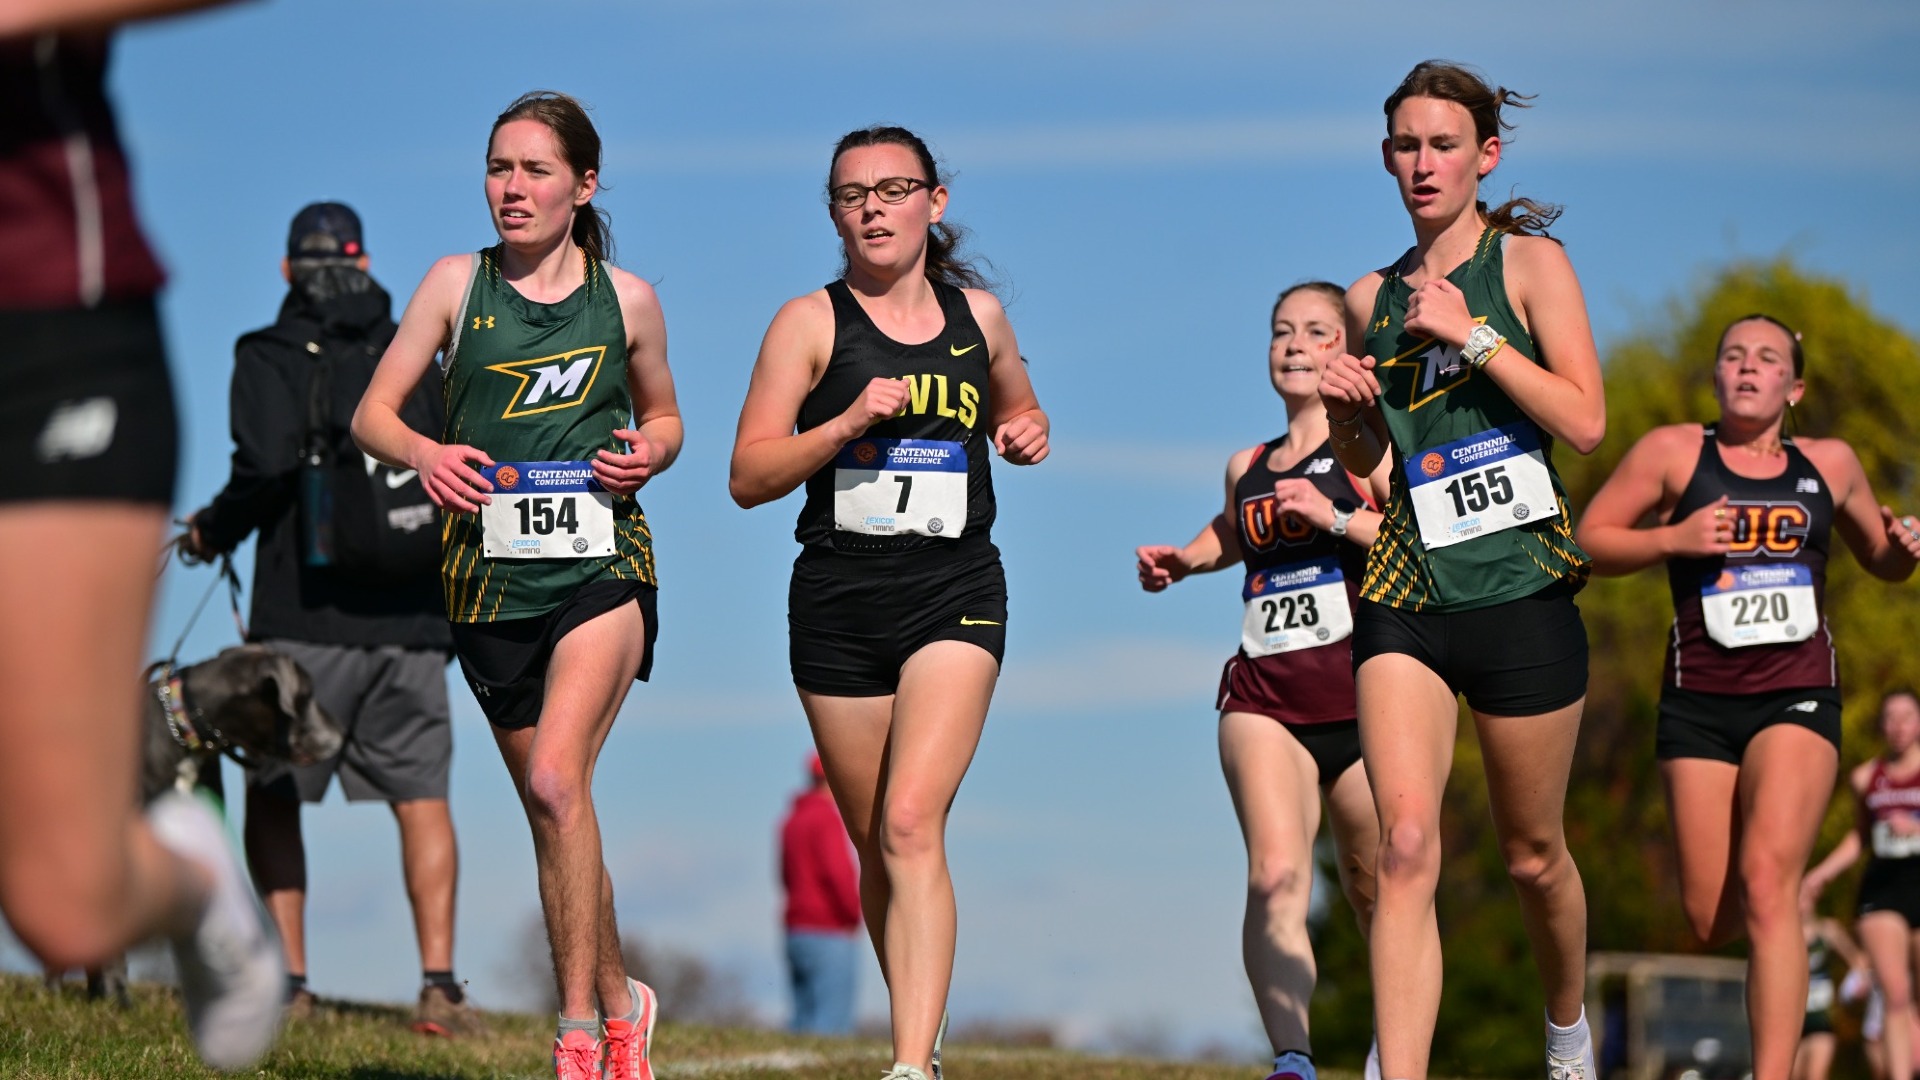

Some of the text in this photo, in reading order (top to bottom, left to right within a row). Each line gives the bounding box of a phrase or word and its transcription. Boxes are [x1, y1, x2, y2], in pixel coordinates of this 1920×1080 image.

[523, 357, 593, 405] M
[877, 374, 980, 429] WLS
[887, 446, 950, 458] CENTENNIAL
[893, 457, 942, 465] CONFERENCE
[1451, 433, 1516, 460] CENTENNIAL
[1459, 444, 1508, 465] CONFERENCE
[527, 469, 593, 479] CENTENNIAL
[534, 478, 584, 486] CONFERENCE
[1445, 465, 1514, 518] 155
[893, 475, 913, 513] 7
[514, 497, 579, 535] 154
[1261, 592, 1320, 634] 223
[1731, 592, 1789, 627] 220
